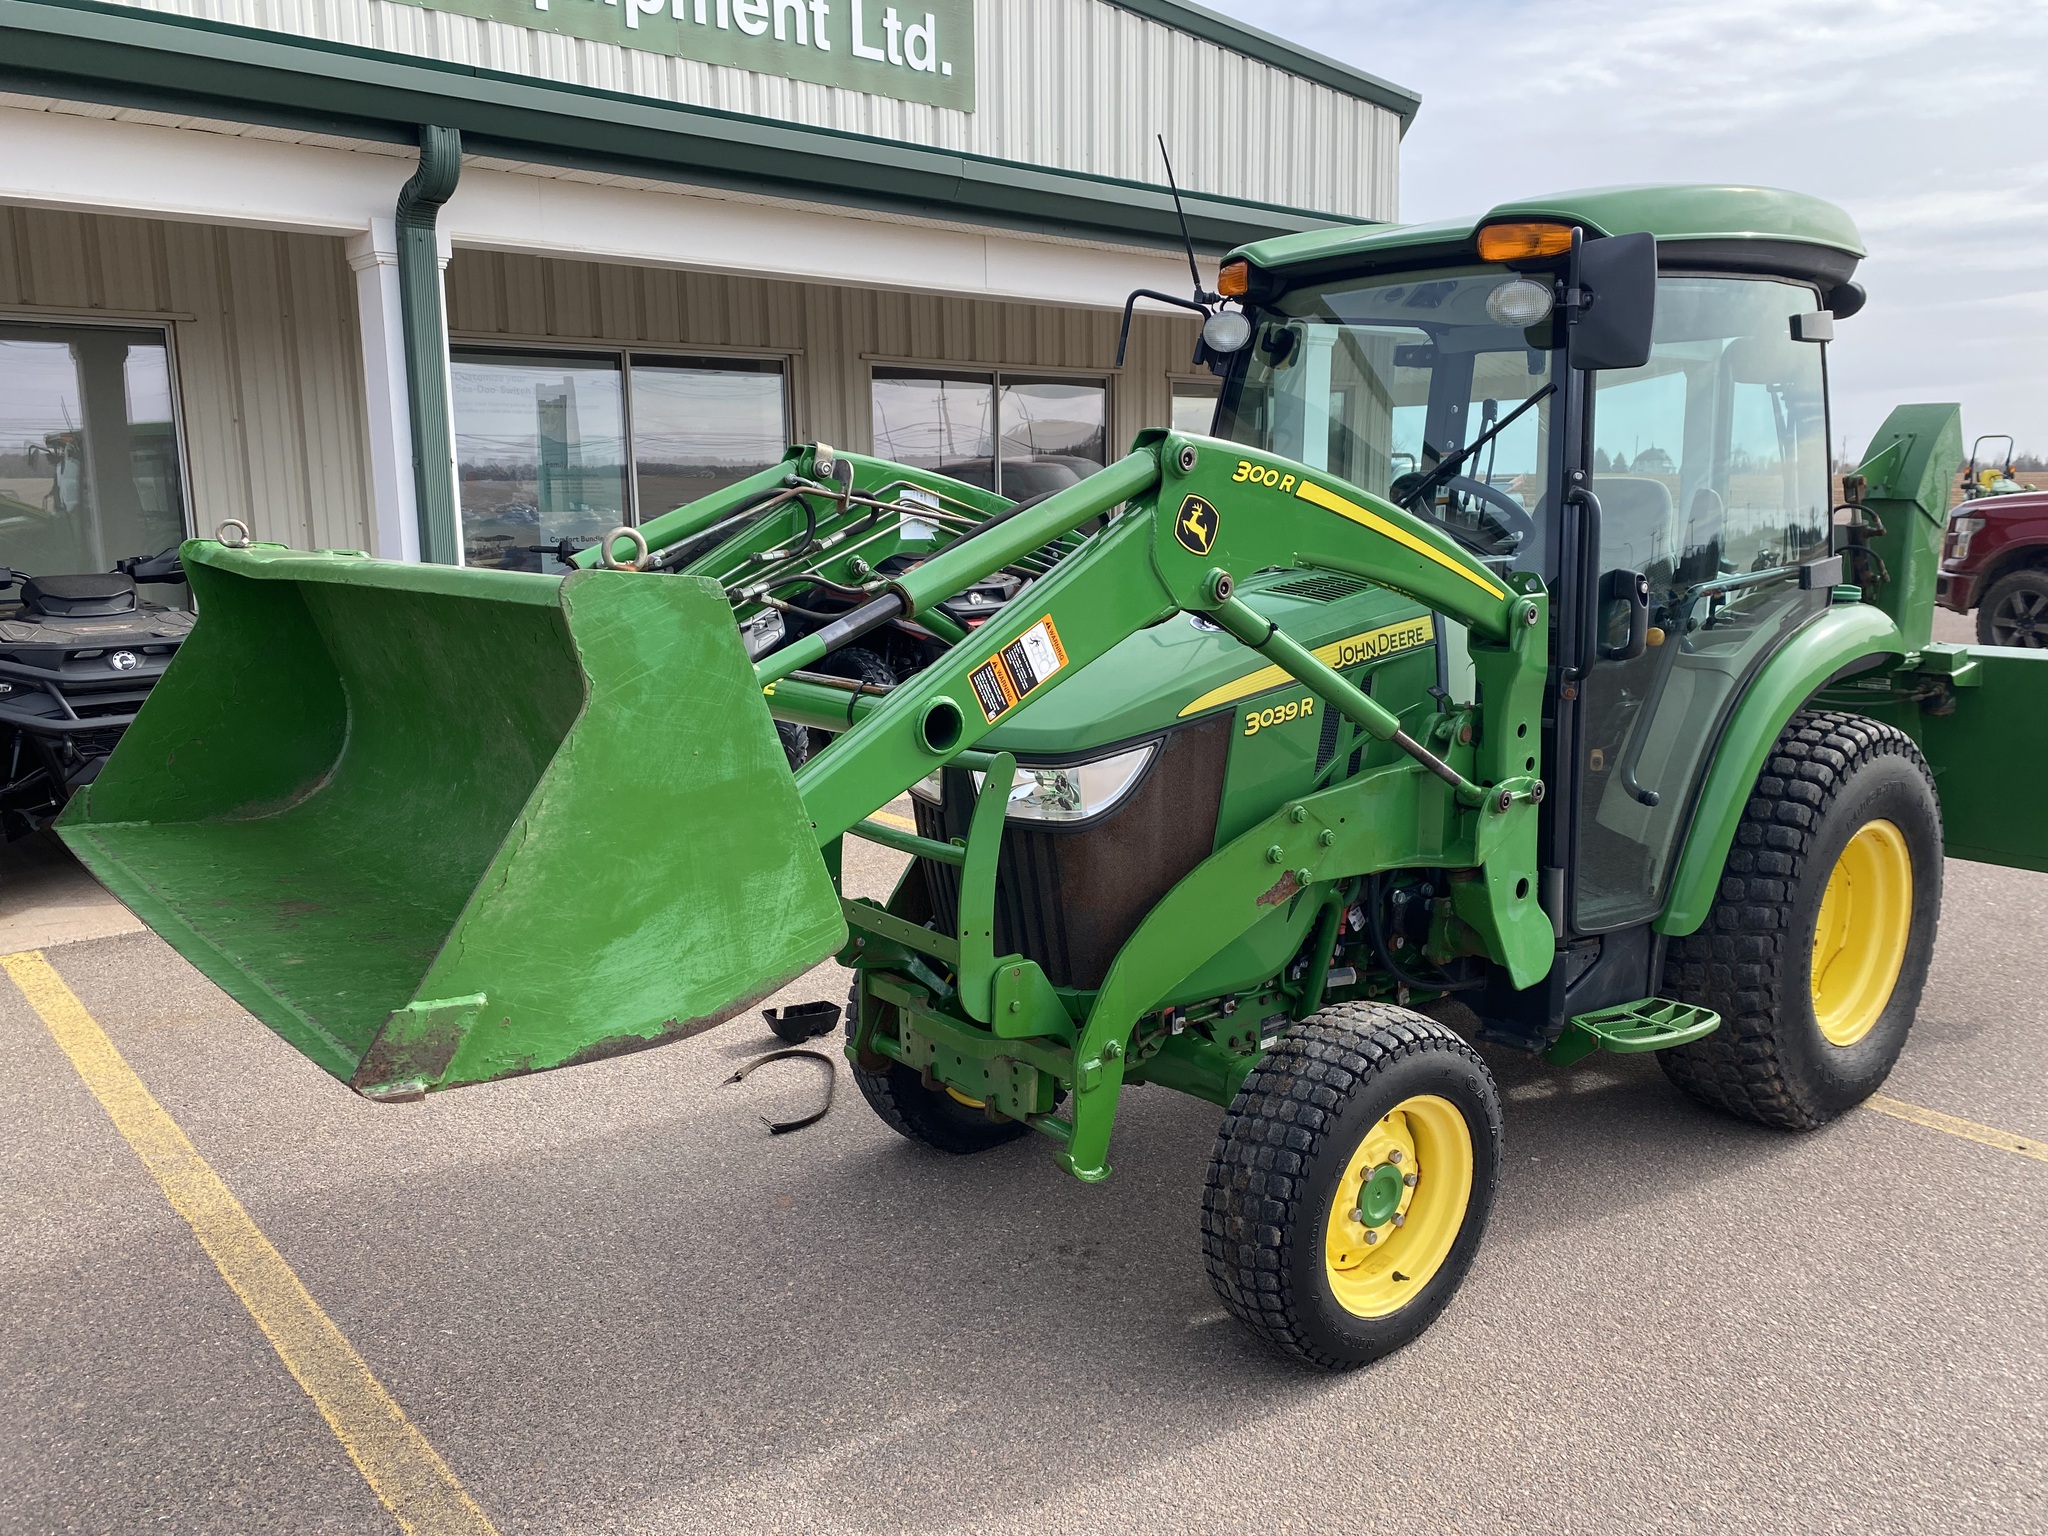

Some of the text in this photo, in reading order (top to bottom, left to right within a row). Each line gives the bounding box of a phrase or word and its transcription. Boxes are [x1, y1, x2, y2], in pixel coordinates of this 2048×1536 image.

[851, 0, 952, 76] Ltd.
[1231, 460, 1279, 488] 300
[1048, 629, 1065, 661] WARNING
[1334, 627, 1425, 667] JOHN DEERE
[996, 669, 1014, 702] WARNING
[1243, 697, 1315, 737] 3039 R
